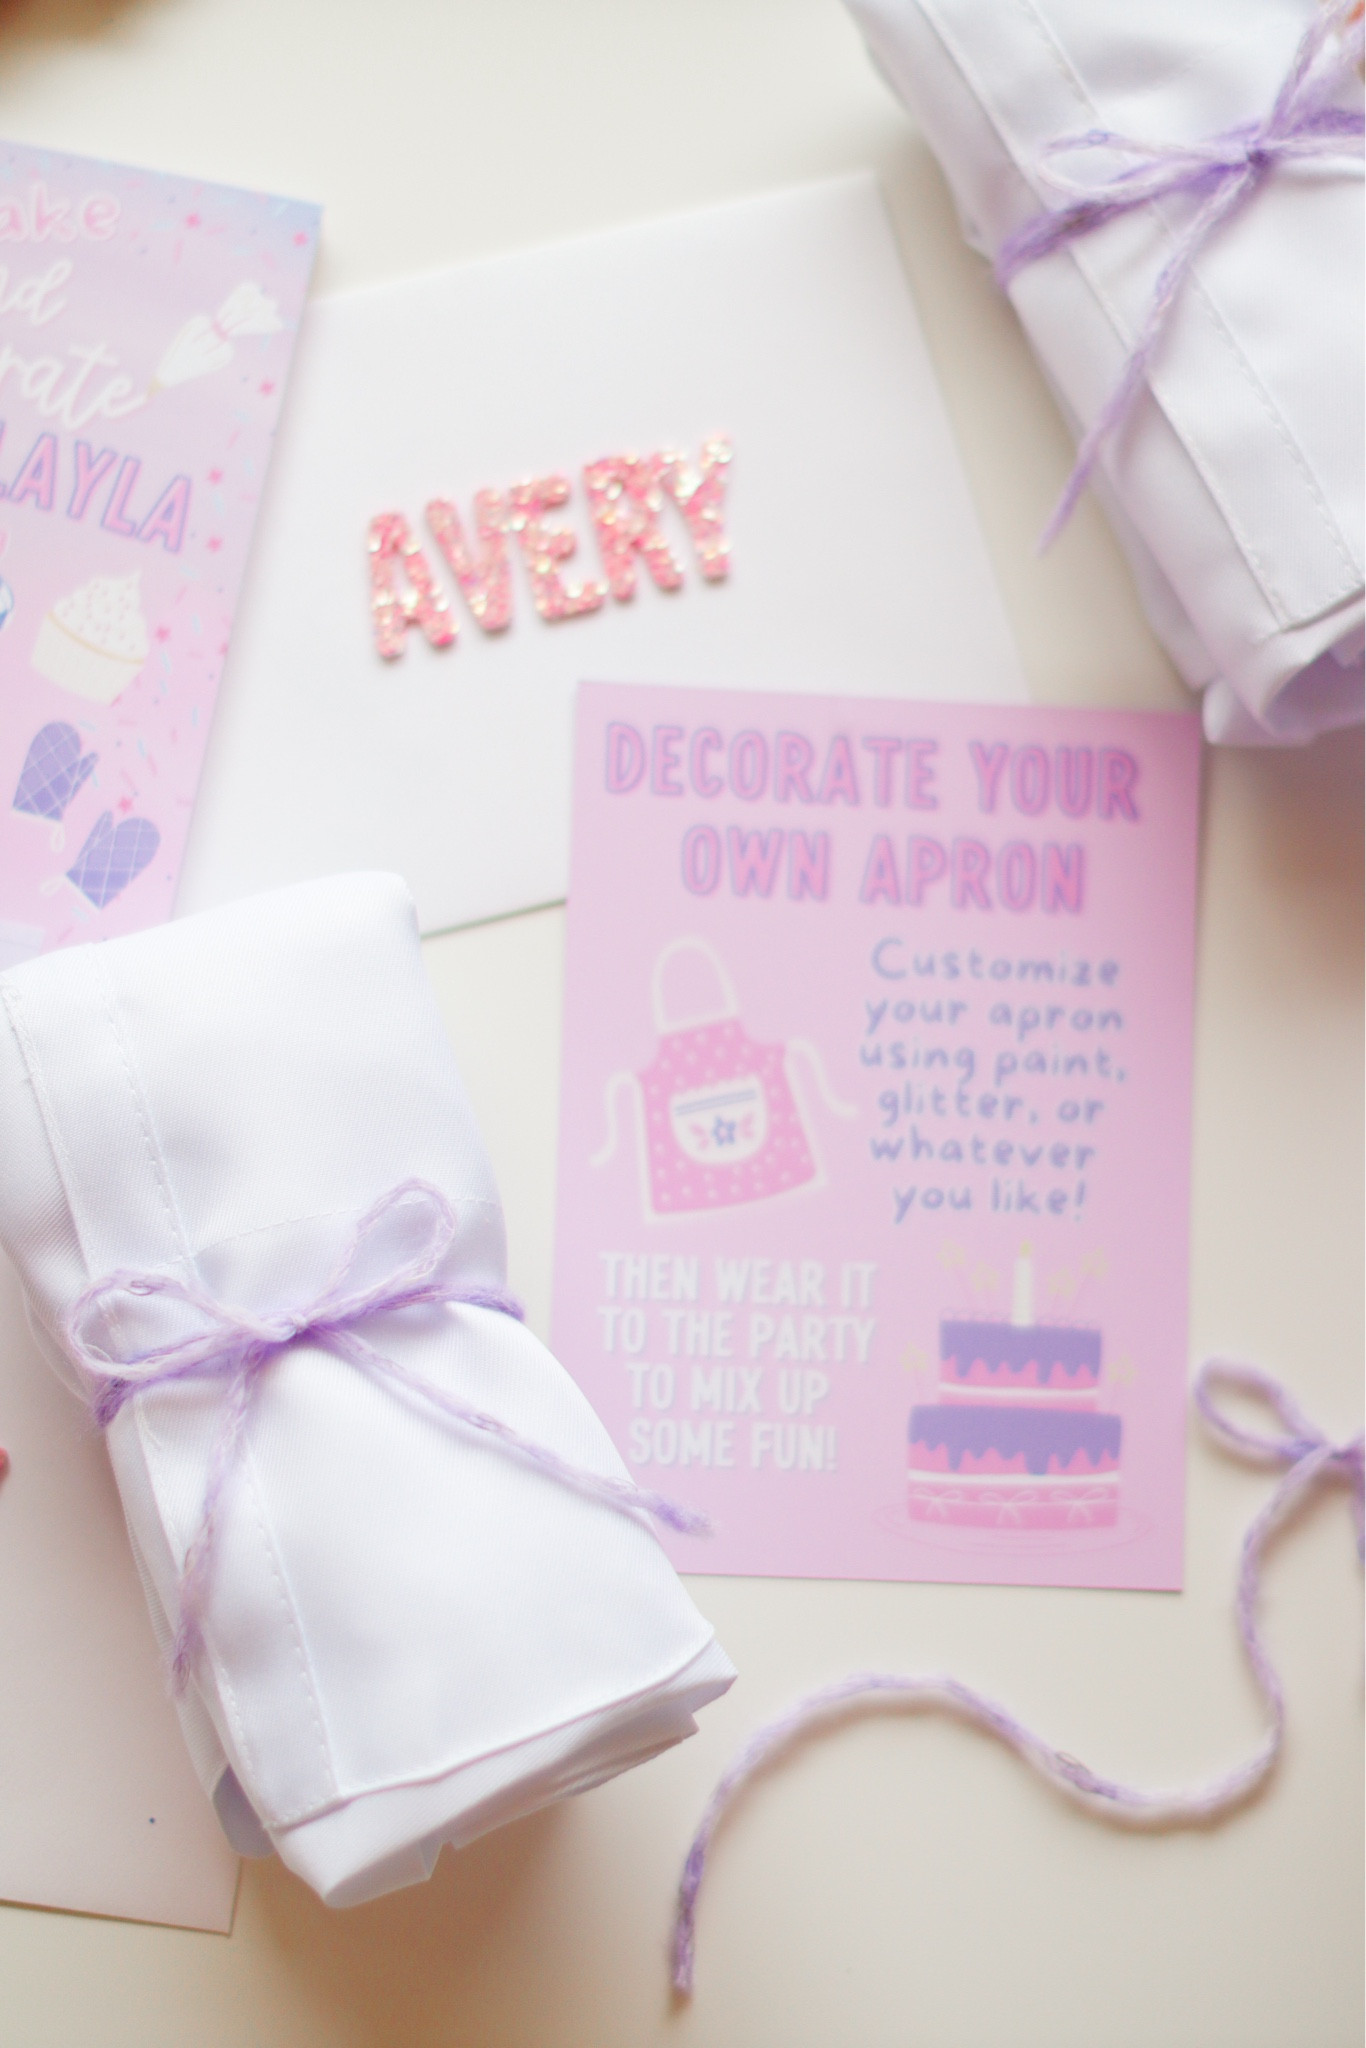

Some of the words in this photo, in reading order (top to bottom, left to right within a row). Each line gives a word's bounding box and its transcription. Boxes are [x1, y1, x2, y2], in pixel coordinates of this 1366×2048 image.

[0, 420, 191, 553] AYLA
[368, 434, 732, 659] AVERY
[605, 721, 939, 810] DECORATE
[970, 739, 1141, 822] YOUR
[681, 824, 829, 900] OWN
[859, 833, 1085, 914] APRON
[871, 936, 1120, 987] Customize
[865, 999, 969, 1037] your
[989, 1001, 1123, 1042] apron
[859, 1038, 976, 1086] using
[1057, 1098, 1105, 1125] or
[869, 1124, 1096, 1170] whatever
[893, 1186, 972, 1225] you
[991, 1177, 1086, 1222] like!
[600, 1252, 700, 1301] THEN
[715, 1256, 826, 1308] WEAR
[841, 1260, 879, 1309] IT
[598, 1305, 648, 1355] TO
[661, 1308, 734, 1359] THE
[750, 1314, 877, 1364] PARTY
[626, 1361, 675, 1410] TO
[692, 1366, 764, 1414] MIX
[779, 1367, 830, 1416] UP
[629, 1416, 736, 1467] SOME
[751, 1421, 838, 1472] FUN!
